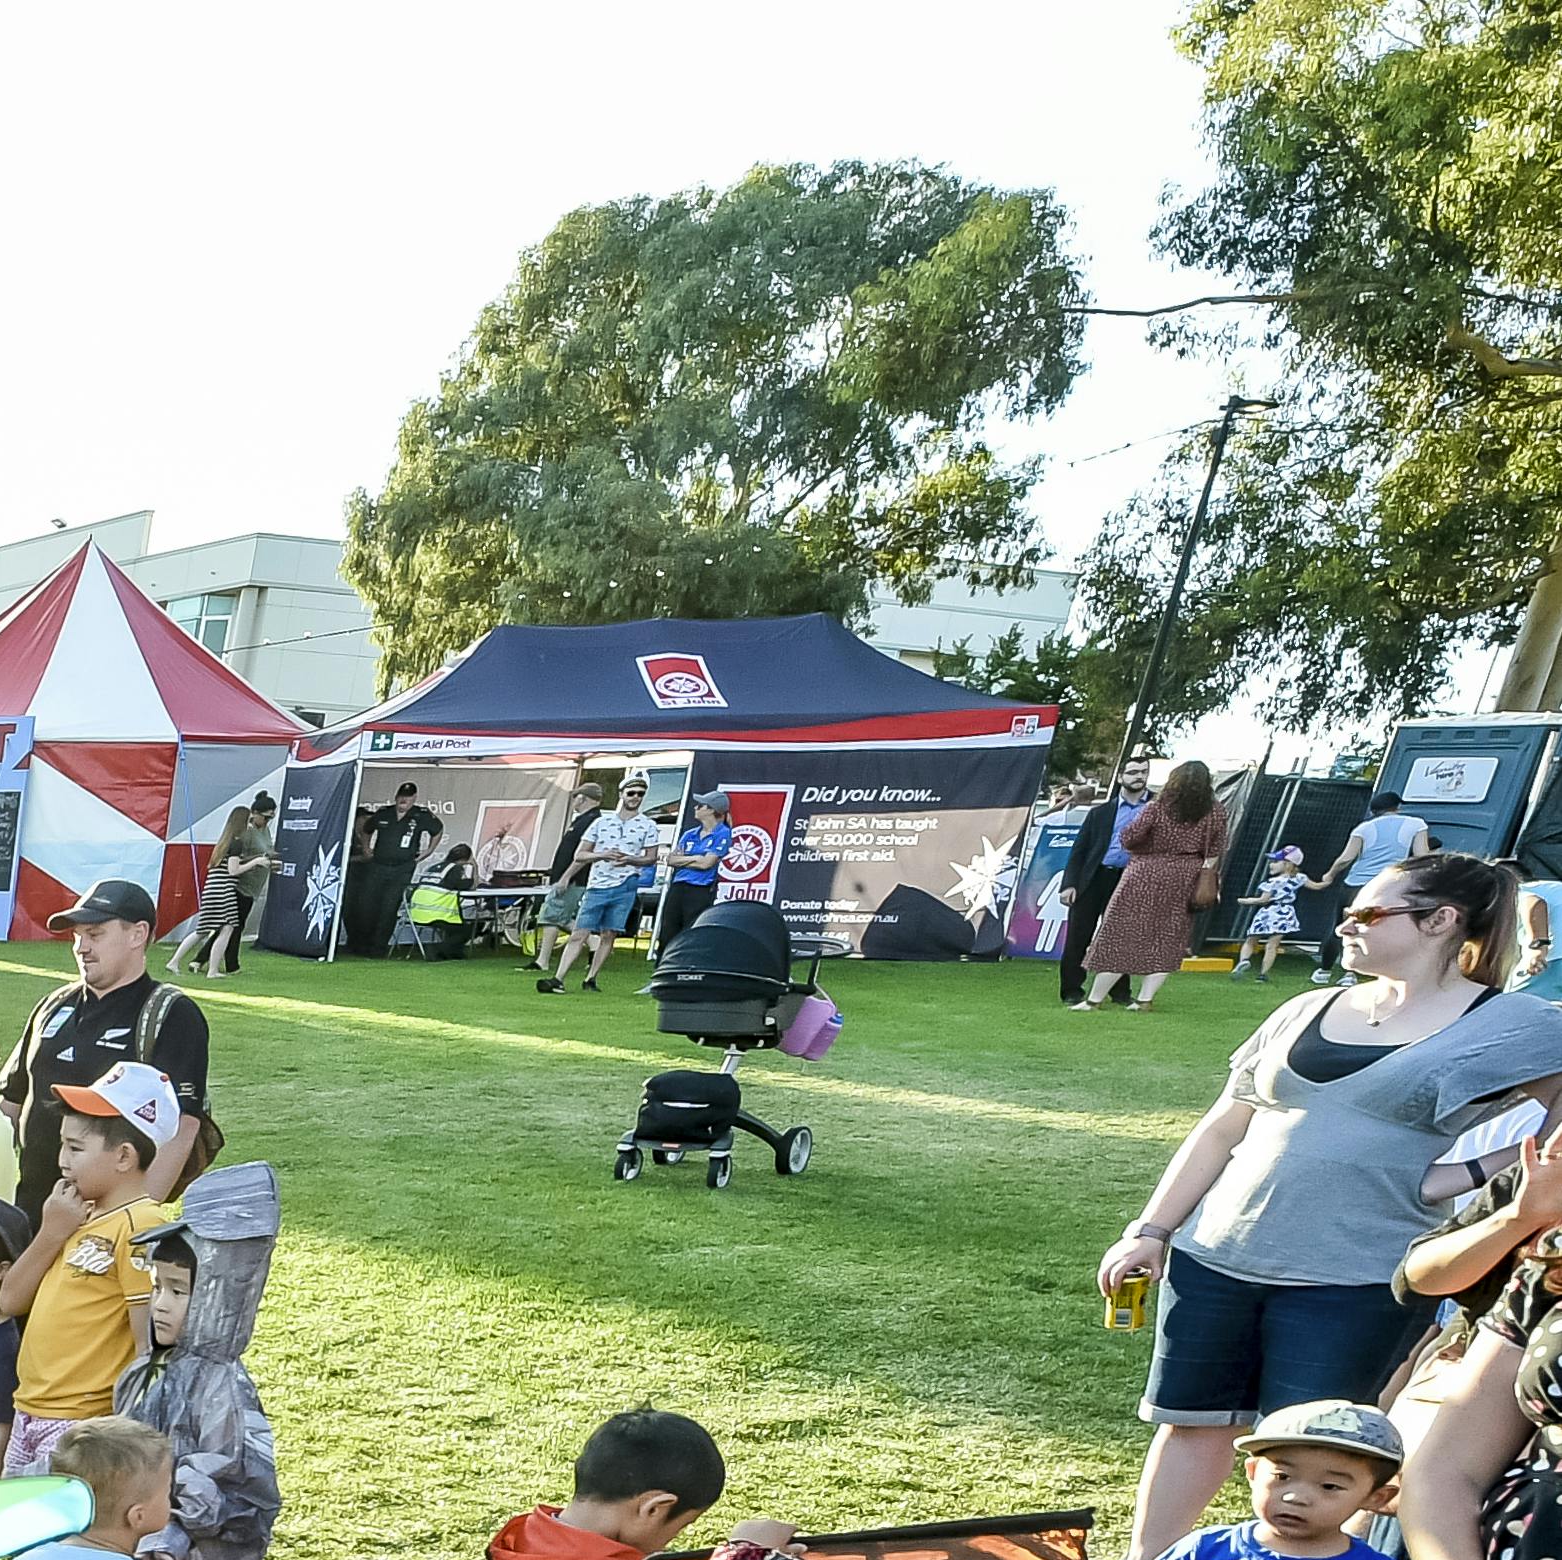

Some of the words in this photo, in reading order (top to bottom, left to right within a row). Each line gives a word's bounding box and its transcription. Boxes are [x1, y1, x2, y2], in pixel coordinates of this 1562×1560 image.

[395, 740, 421, 750] First
[422, 740, 444, 749] Aid
[445, 739, 471, 748] Post
[801, 786, 838, 803] Did
[836, 787, 877, 805] you
[878, 786, 942, 802] know...
[793, 819, 809, 830] St
[809, 818, 845, 830] John
[846, 818, 868, 830] SA
[870, 817, 894, 830] has
[894, 817, 939, 833] taught
[790, 837, 820, 847] over
[821, 833, 875, 847] 50,000
[875, 834, 920, 846] school
[787, 850, 840, 862] children
[842, 849, 870, 862] first
[871, 849, 897, 862] aid.
[724, 882, 769, 901] John
[780, 900, 823, 910] Donate
[824, 899, 860, 912] today
